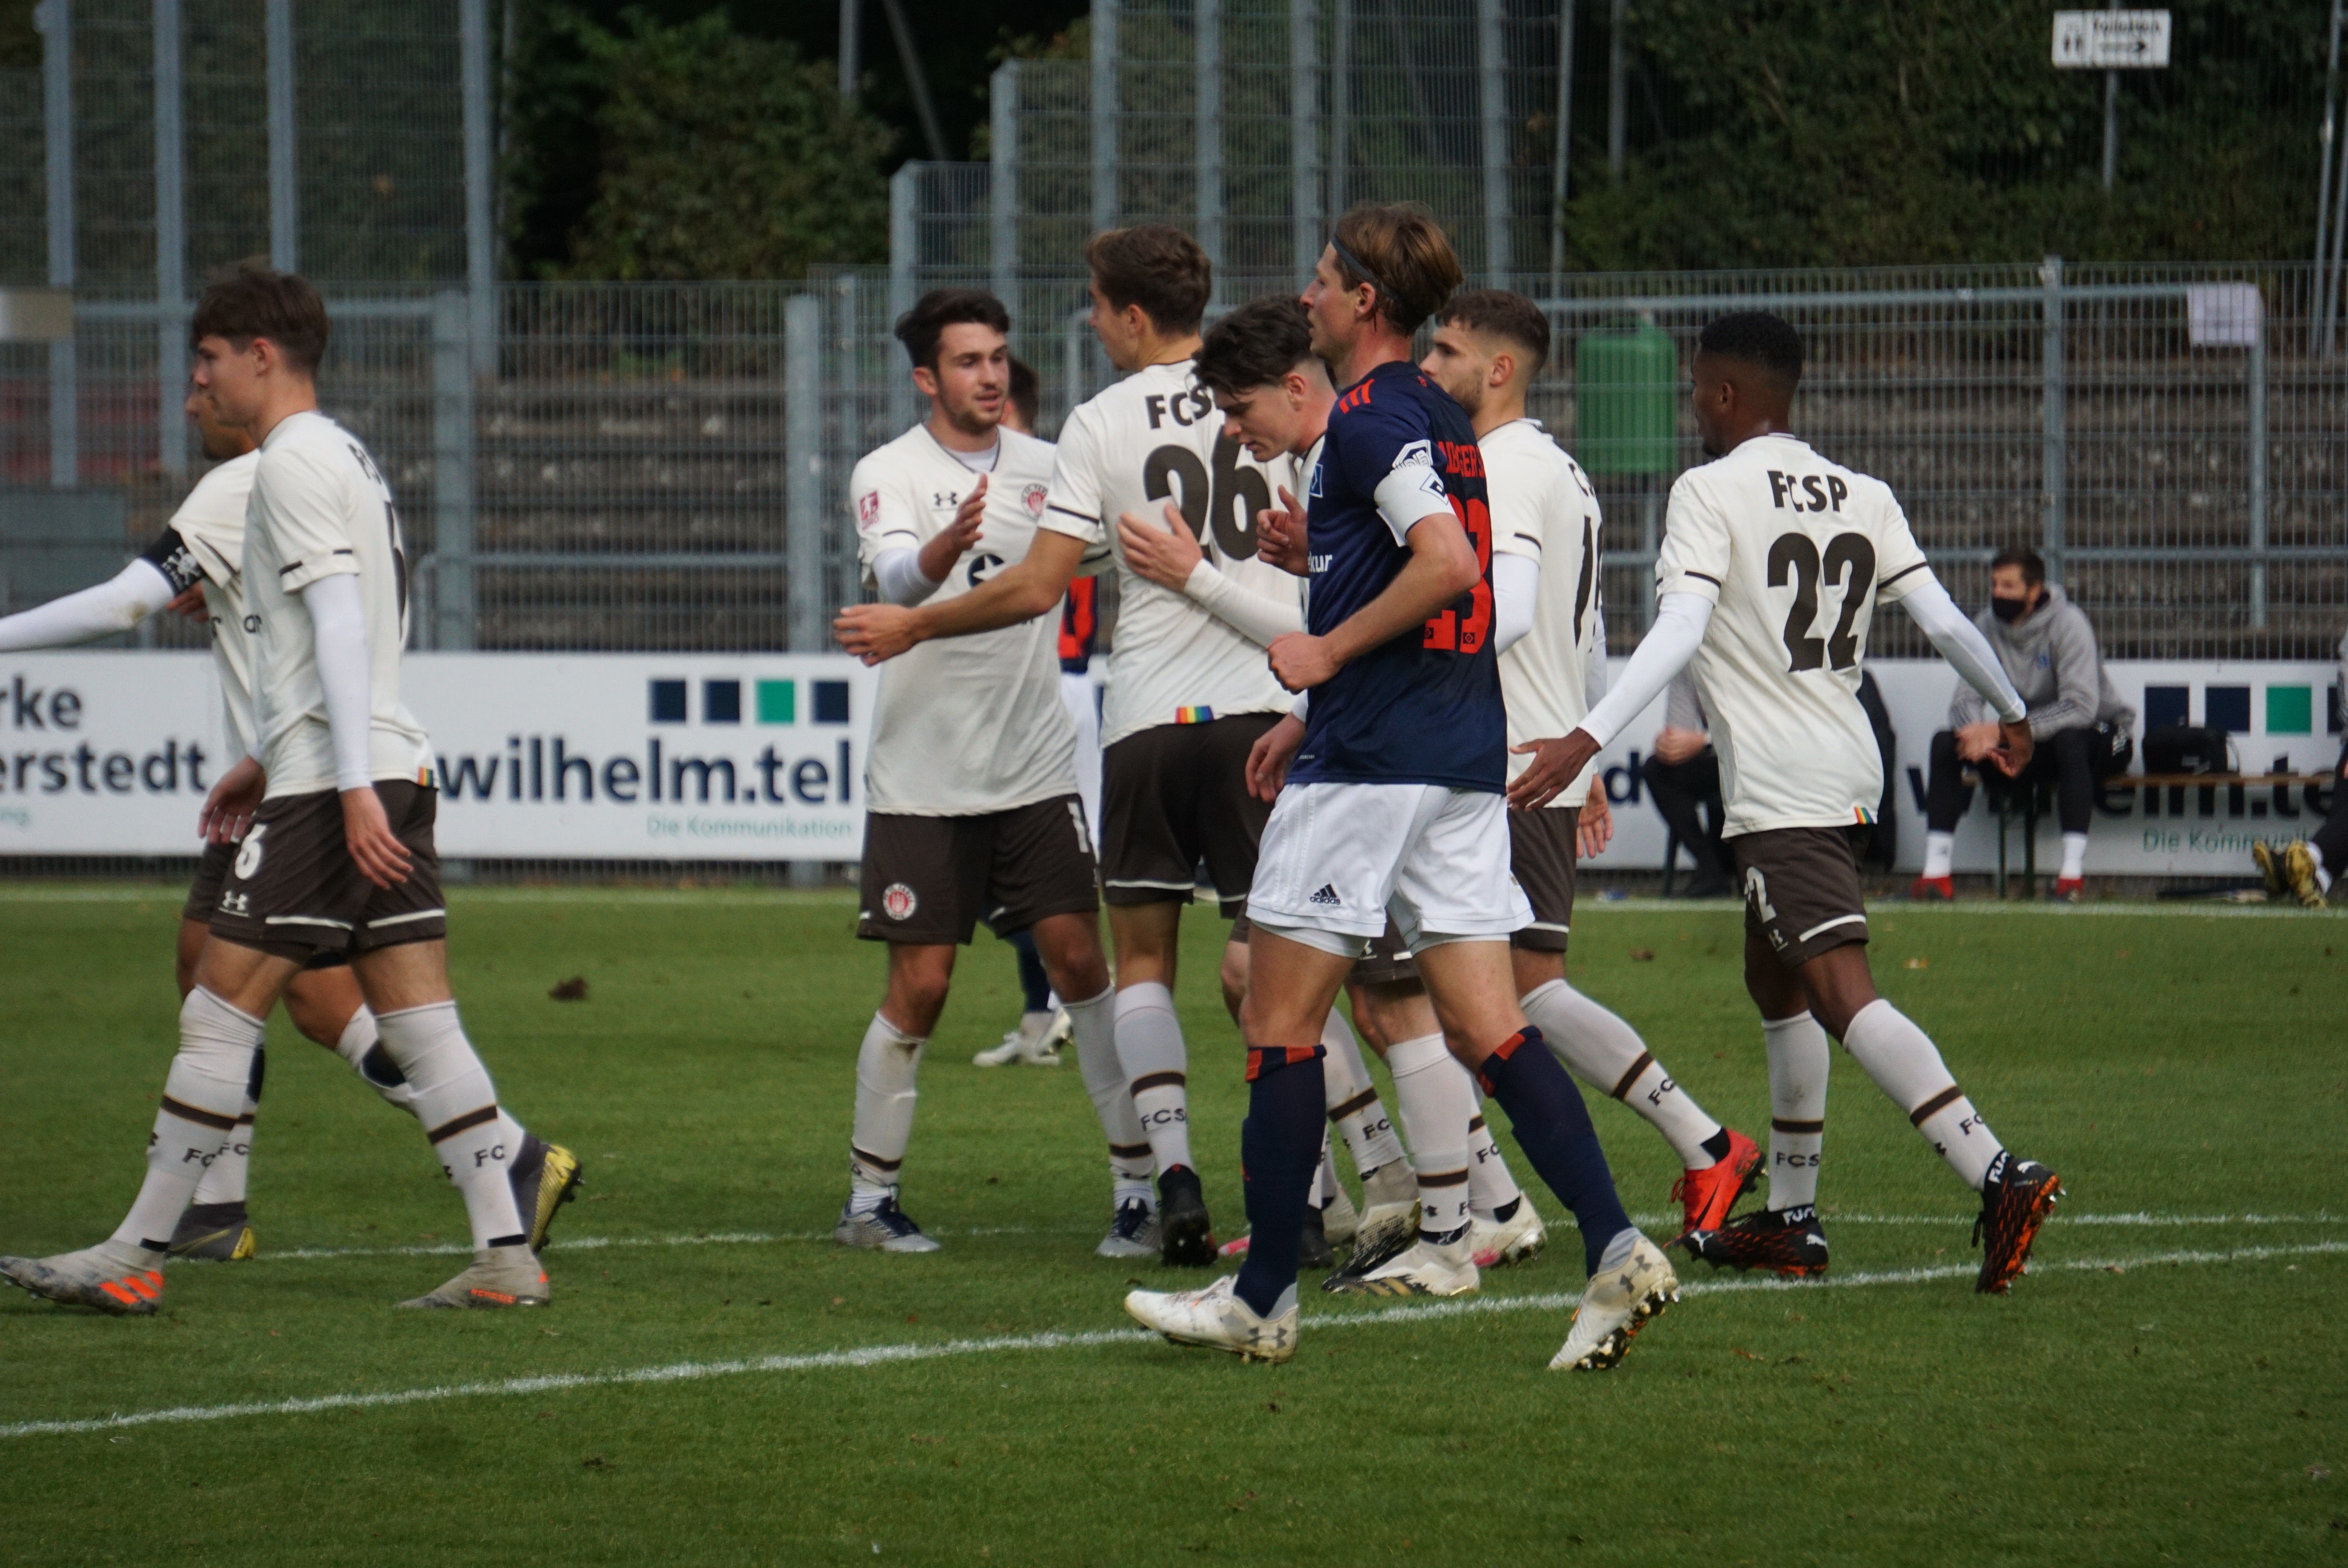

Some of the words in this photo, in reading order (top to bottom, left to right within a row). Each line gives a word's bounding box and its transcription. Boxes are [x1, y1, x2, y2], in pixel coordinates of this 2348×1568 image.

[1145, 384, 1212, 429] FCS
[1767, 471, 1847, 512] FCSP
[1768, 532, 1876, 673] 22
[0, 675, 81, 729] ke
[0, 738, 207, 793] rstedt
[437, 735, 851, 805] wilhelm.tel
[235, 823, 267, 880] 6
[687, 816, 852, 838] Kommunikation
[1309, 895, 1341, 906] adidas
[1744, 866, 1777, 924] 2
